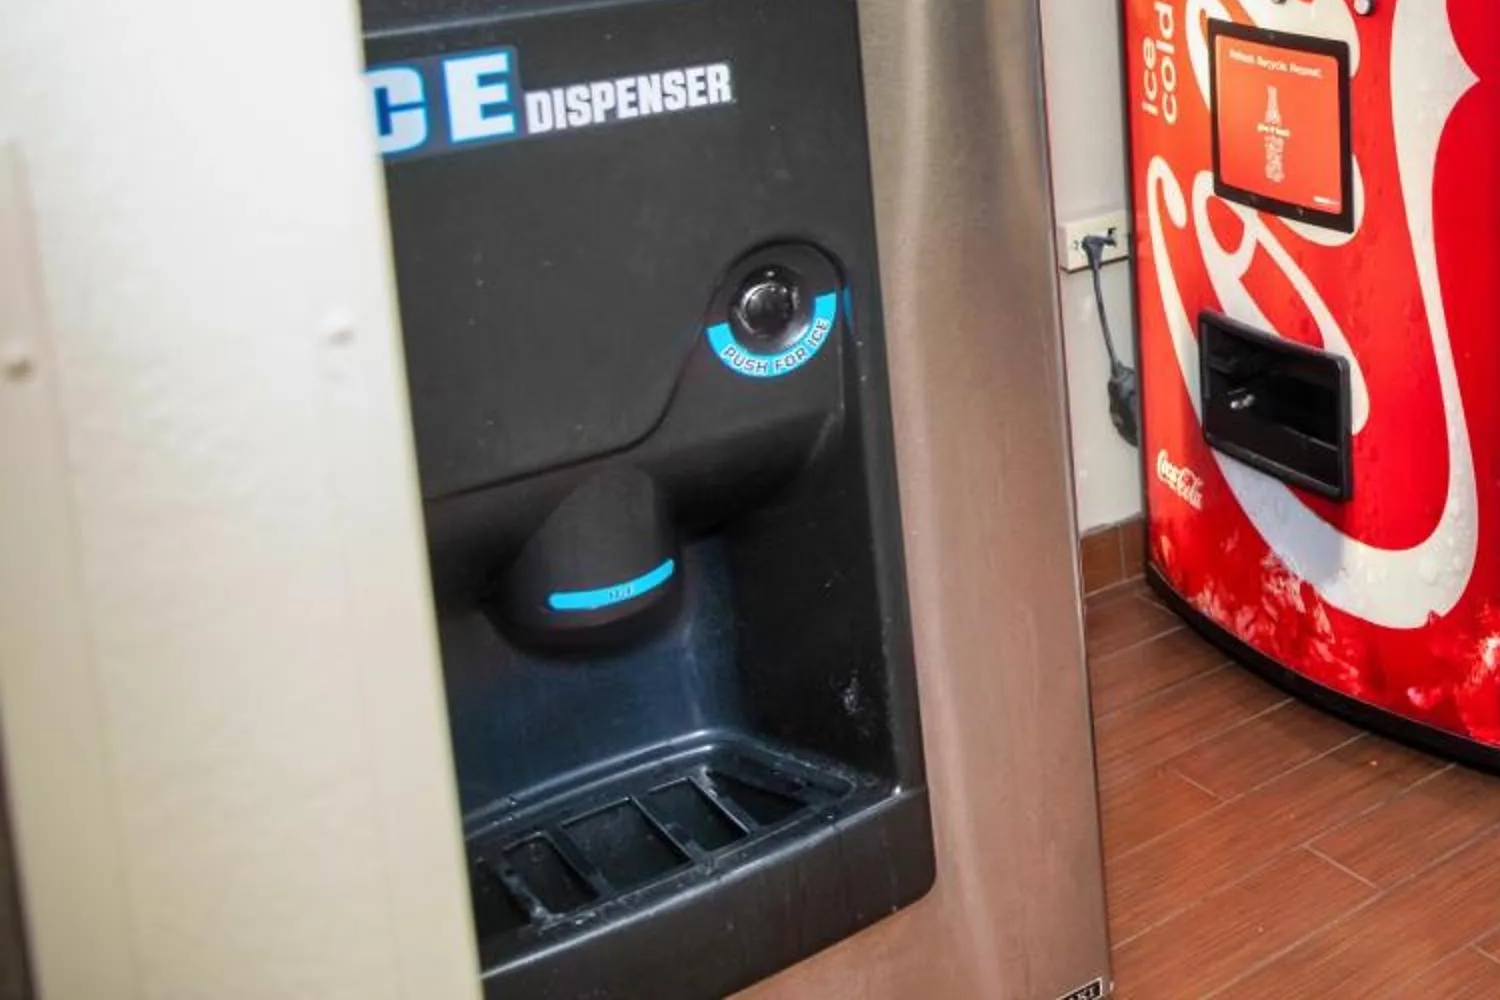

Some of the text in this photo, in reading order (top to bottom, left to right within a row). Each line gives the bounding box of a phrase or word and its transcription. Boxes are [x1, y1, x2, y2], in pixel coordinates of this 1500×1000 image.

[364, 50, 732, 154] CE DISPENSER
[1155, 1, 1177, 125] cold
[723, 319, 827, 374] PUSH FOR ICE
